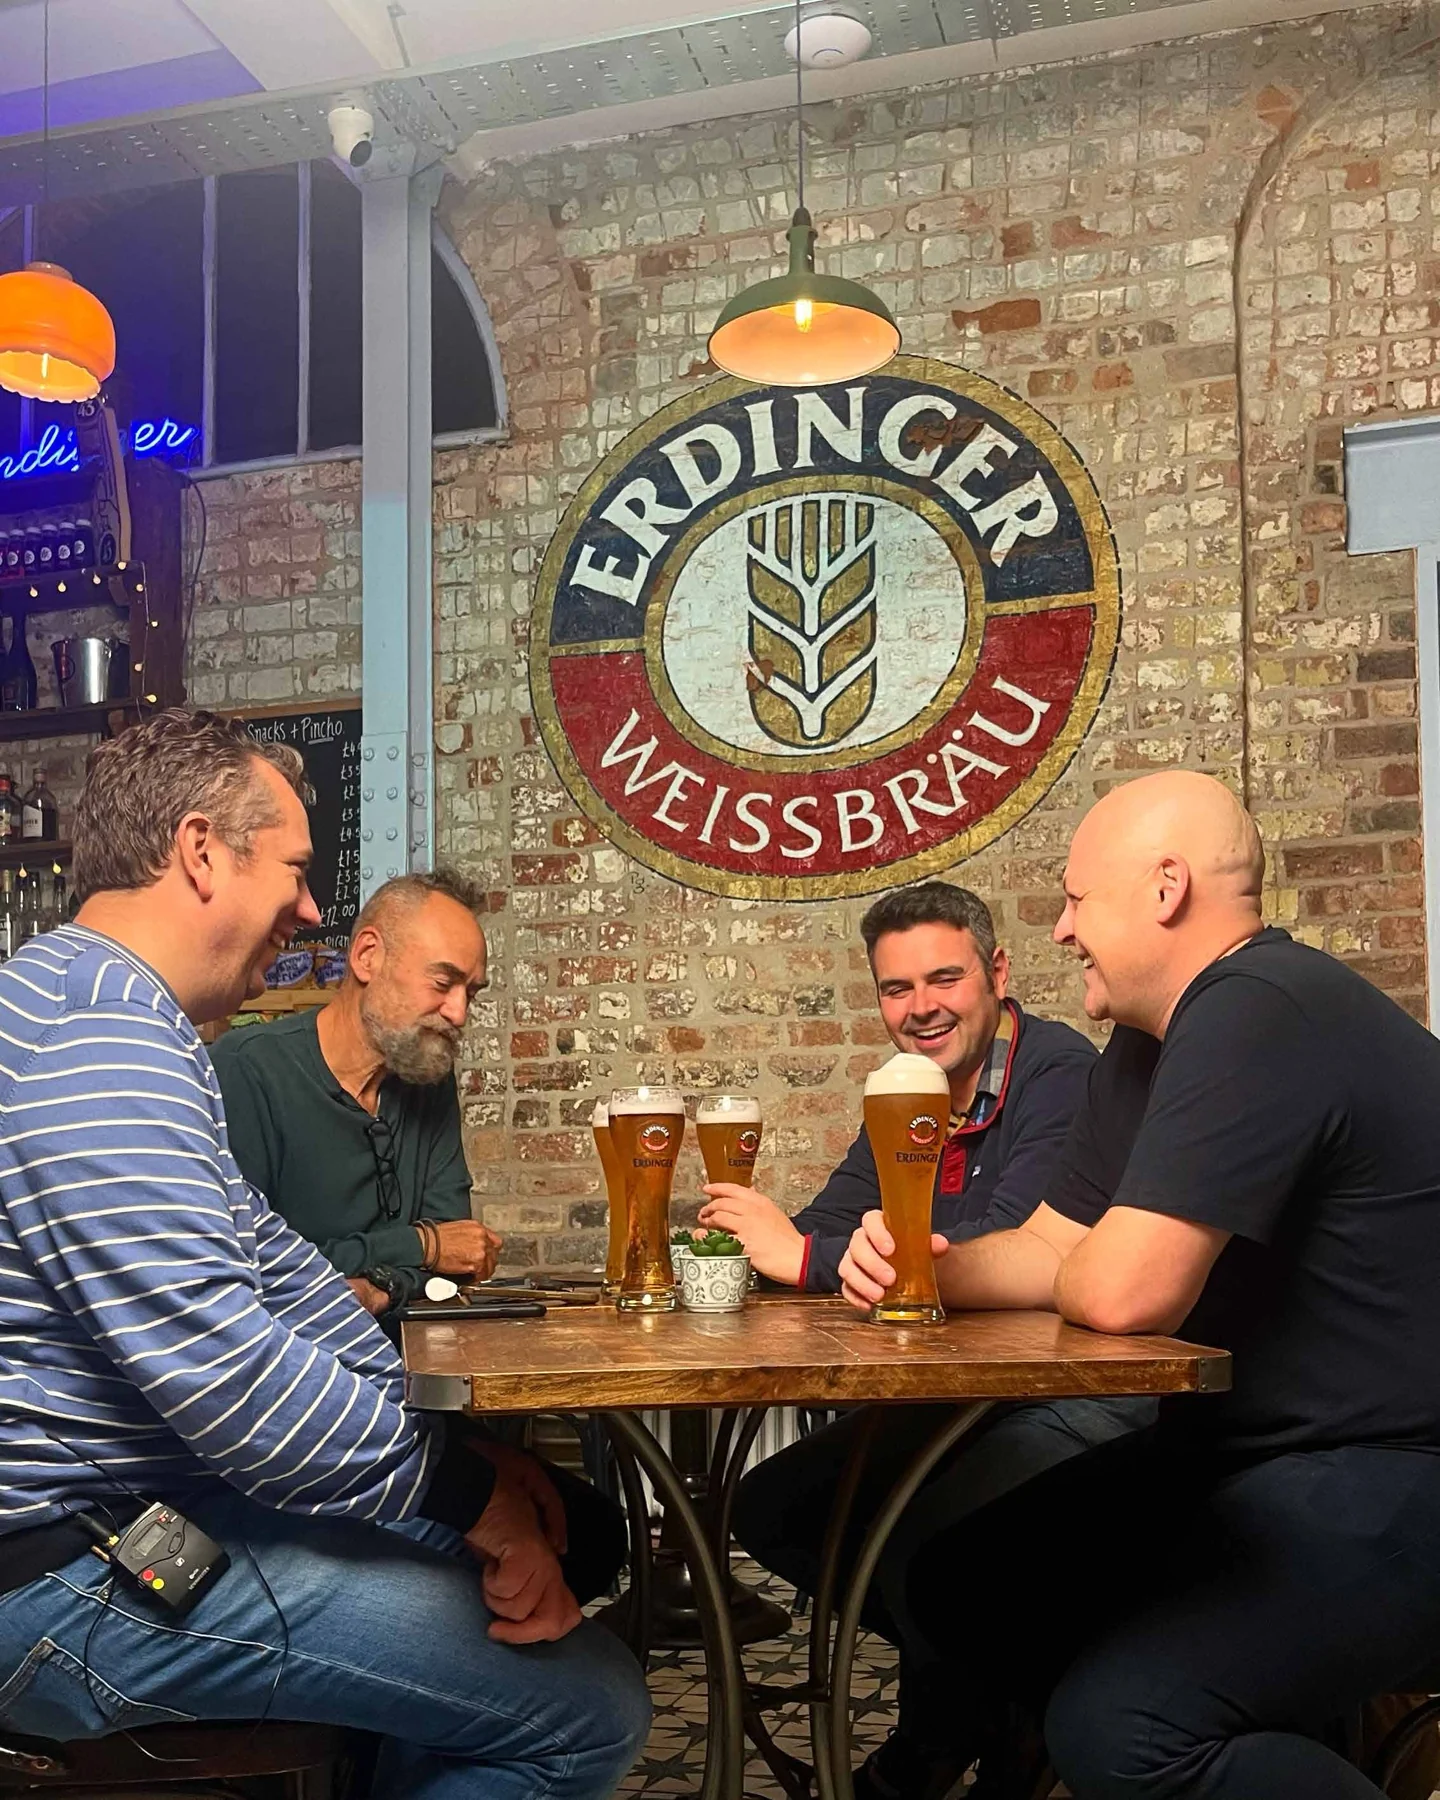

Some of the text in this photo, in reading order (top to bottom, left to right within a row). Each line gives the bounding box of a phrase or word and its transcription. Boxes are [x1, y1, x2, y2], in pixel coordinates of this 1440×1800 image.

[570, 386, 1059, 606] ERDINGER
[248, 721, 285, 742] Snacks
[601, 677, 1050, 859] WEISSBRÄU
